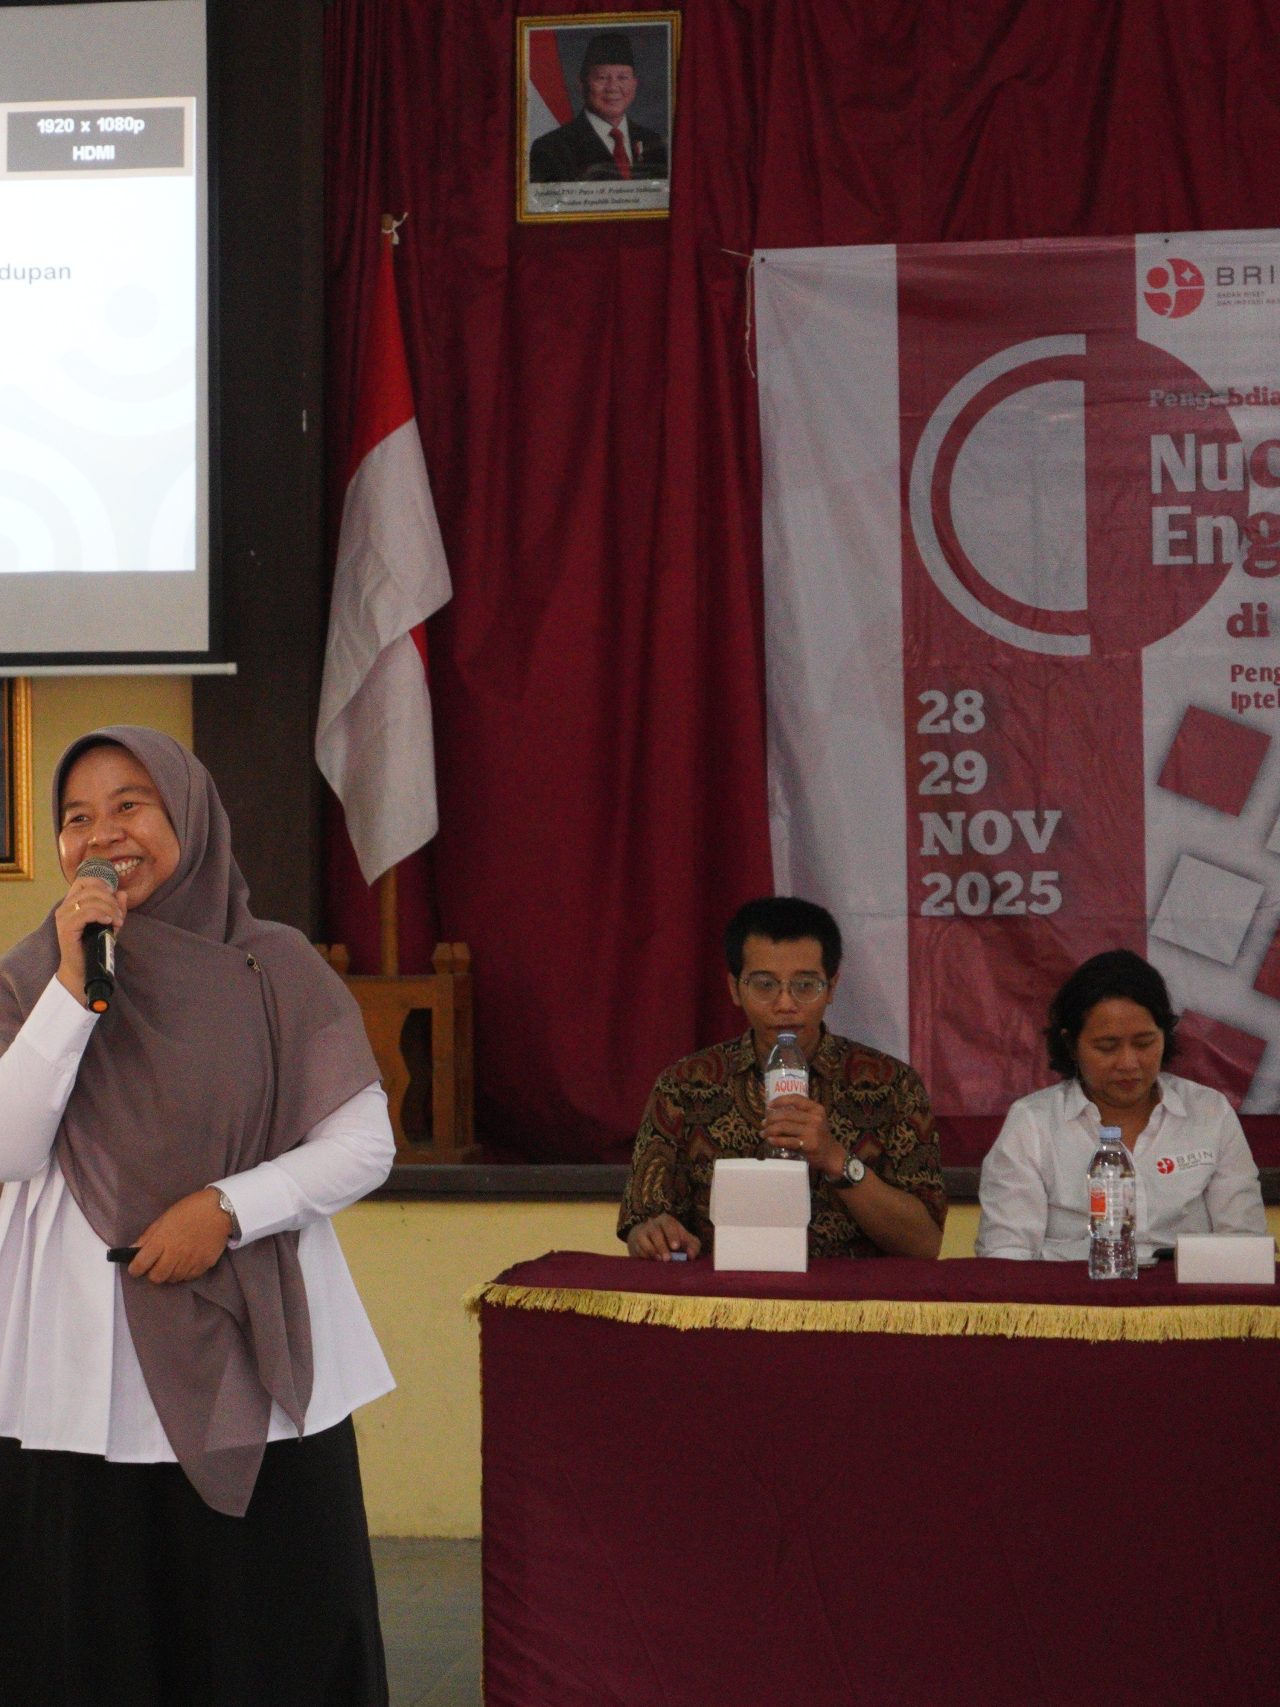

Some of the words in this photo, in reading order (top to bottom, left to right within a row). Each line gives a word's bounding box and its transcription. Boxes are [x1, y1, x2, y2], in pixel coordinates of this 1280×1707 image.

[37, 118, 75, 134] 1920
[80, 120, 91, 133] x
[97, 116, 145, 134] 1080p
[72, 145, 115, 160] HDMI
[1226, 602, 1271, 638] di
[917, 689, 986, 734] 28
[1231, 688, 1280, 714] Ipte
[918, 750, 988, 795] 29
[919, 810, 1062, 856] NOV
[920, 870, 1062, 916] 2025
